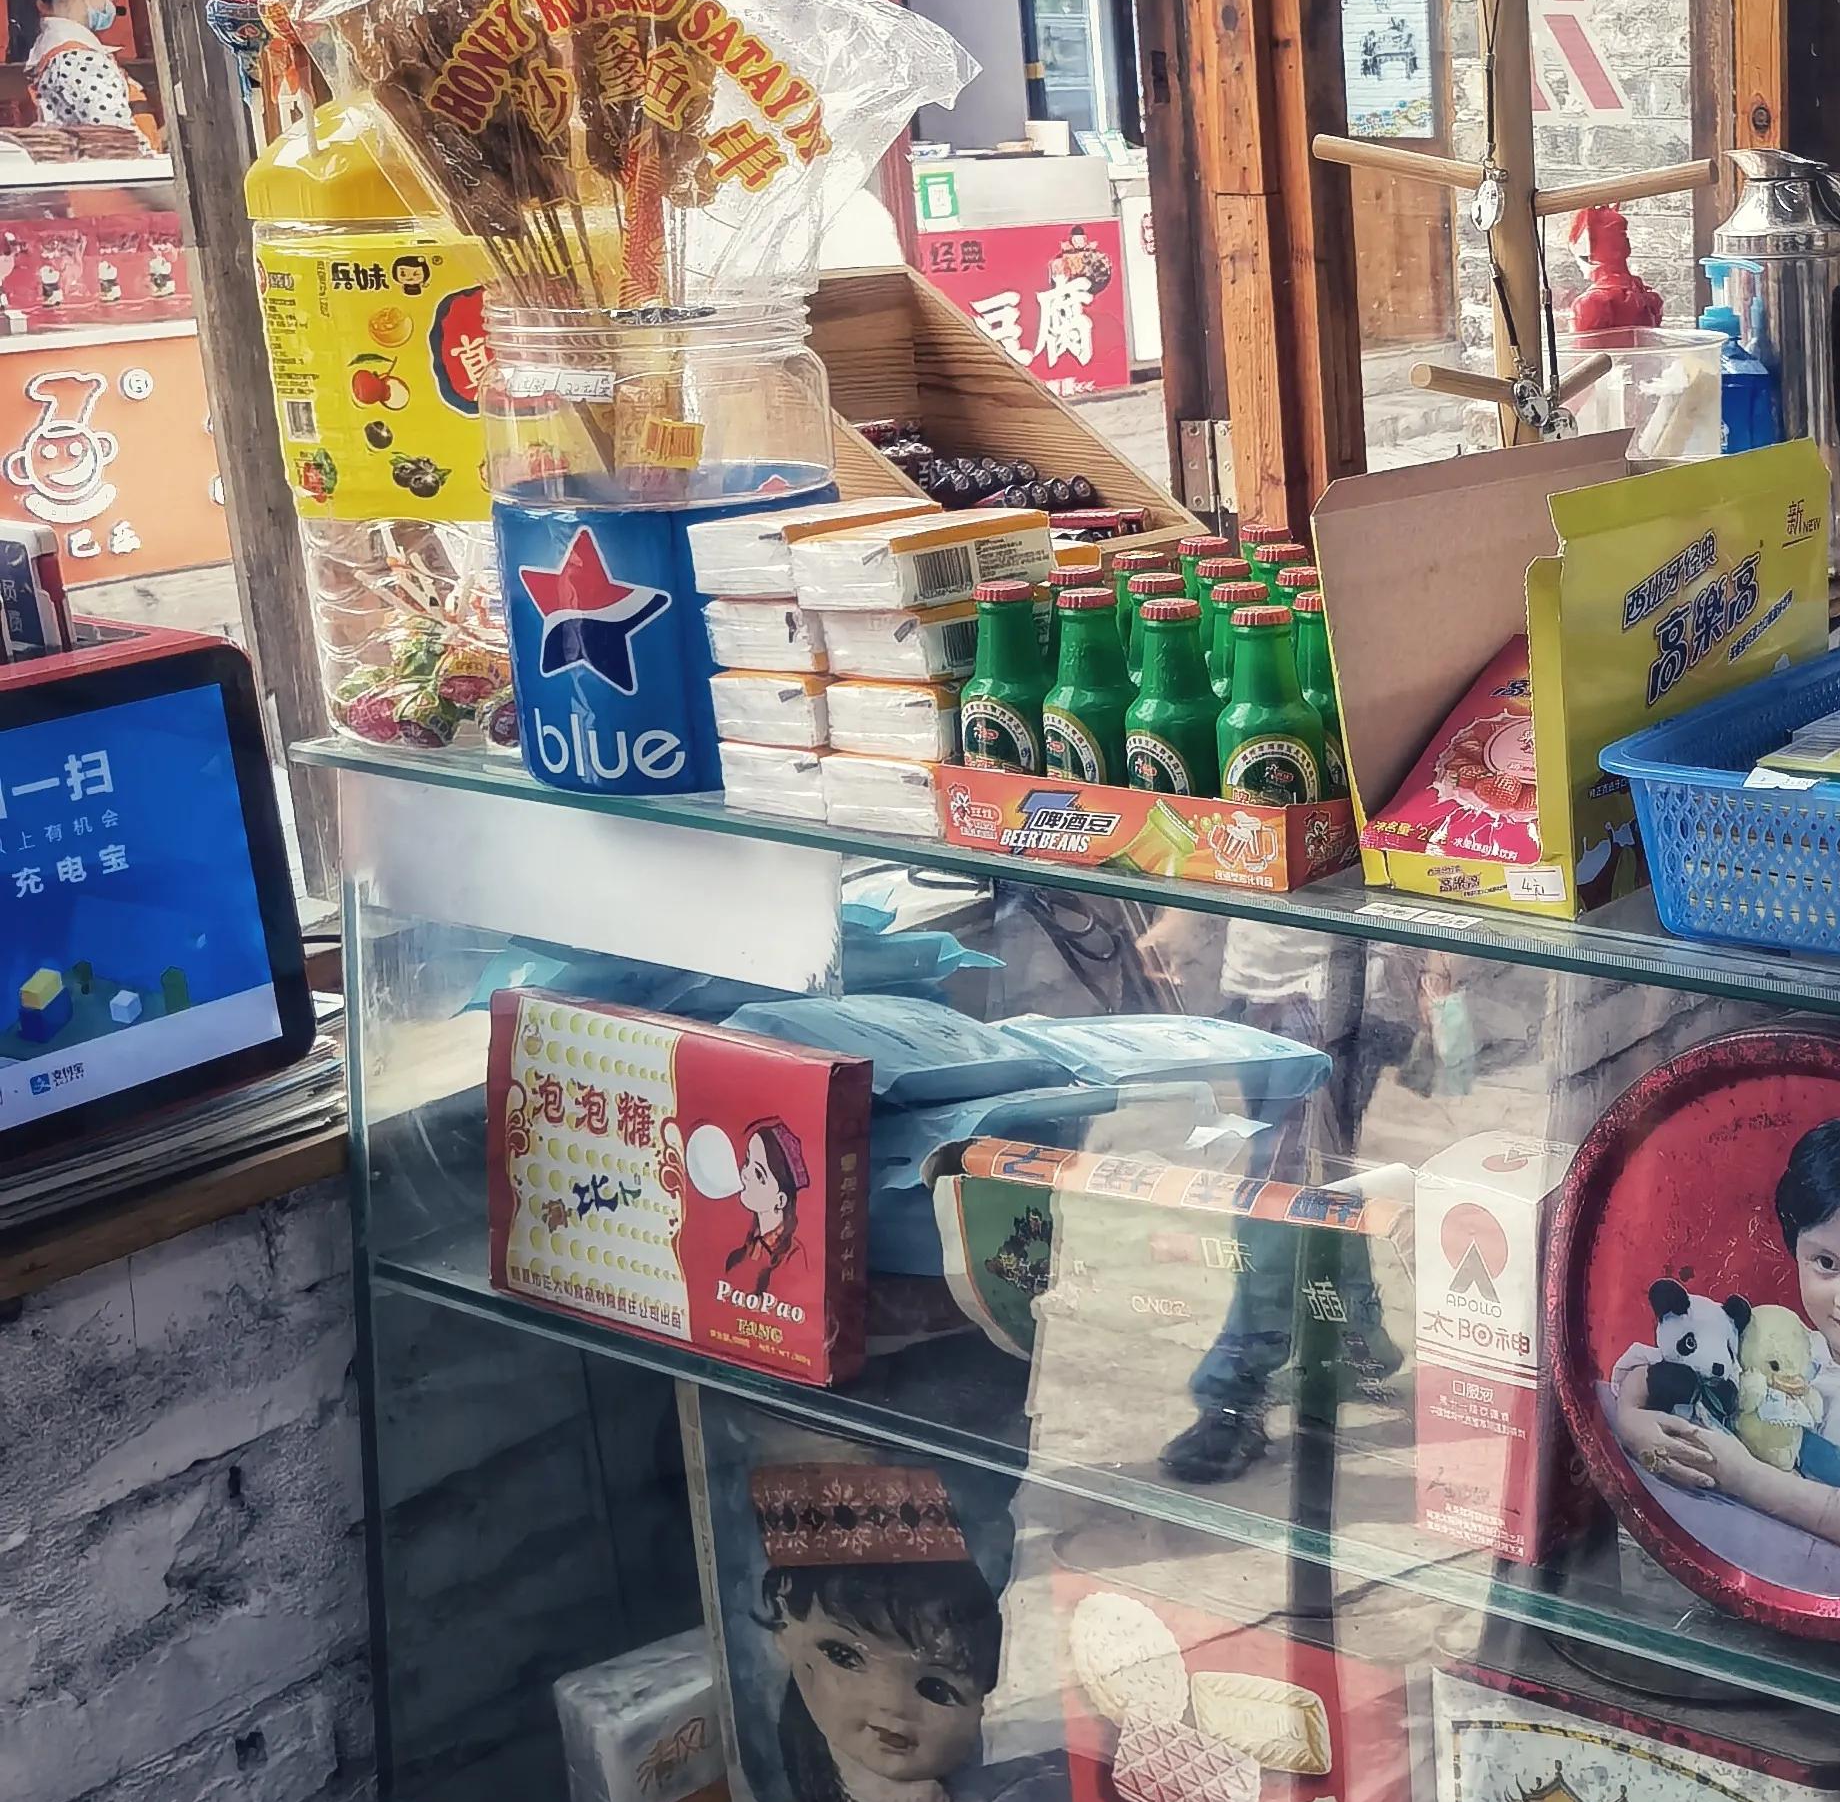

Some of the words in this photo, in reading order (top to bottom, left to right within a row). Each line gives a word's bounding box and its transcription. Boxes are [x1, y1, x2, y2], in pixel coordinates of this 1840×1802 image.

[1803, 517, 1821, 534] NEW
[534, 708, 686, 781] blue
[1034, 812, 1113, 835] 啤酒豆
[1000, 829, 1036, 851] BEER
[1038, 832, 1091, 854] BEANS
[12, 844, 131, 898] 充电宝
[532, 1073, 654, 1147] 泡泡糖
[716, 1279, 806, 1325] PaoPao
[1446, 1294, 1503, 1318] APOLLO
